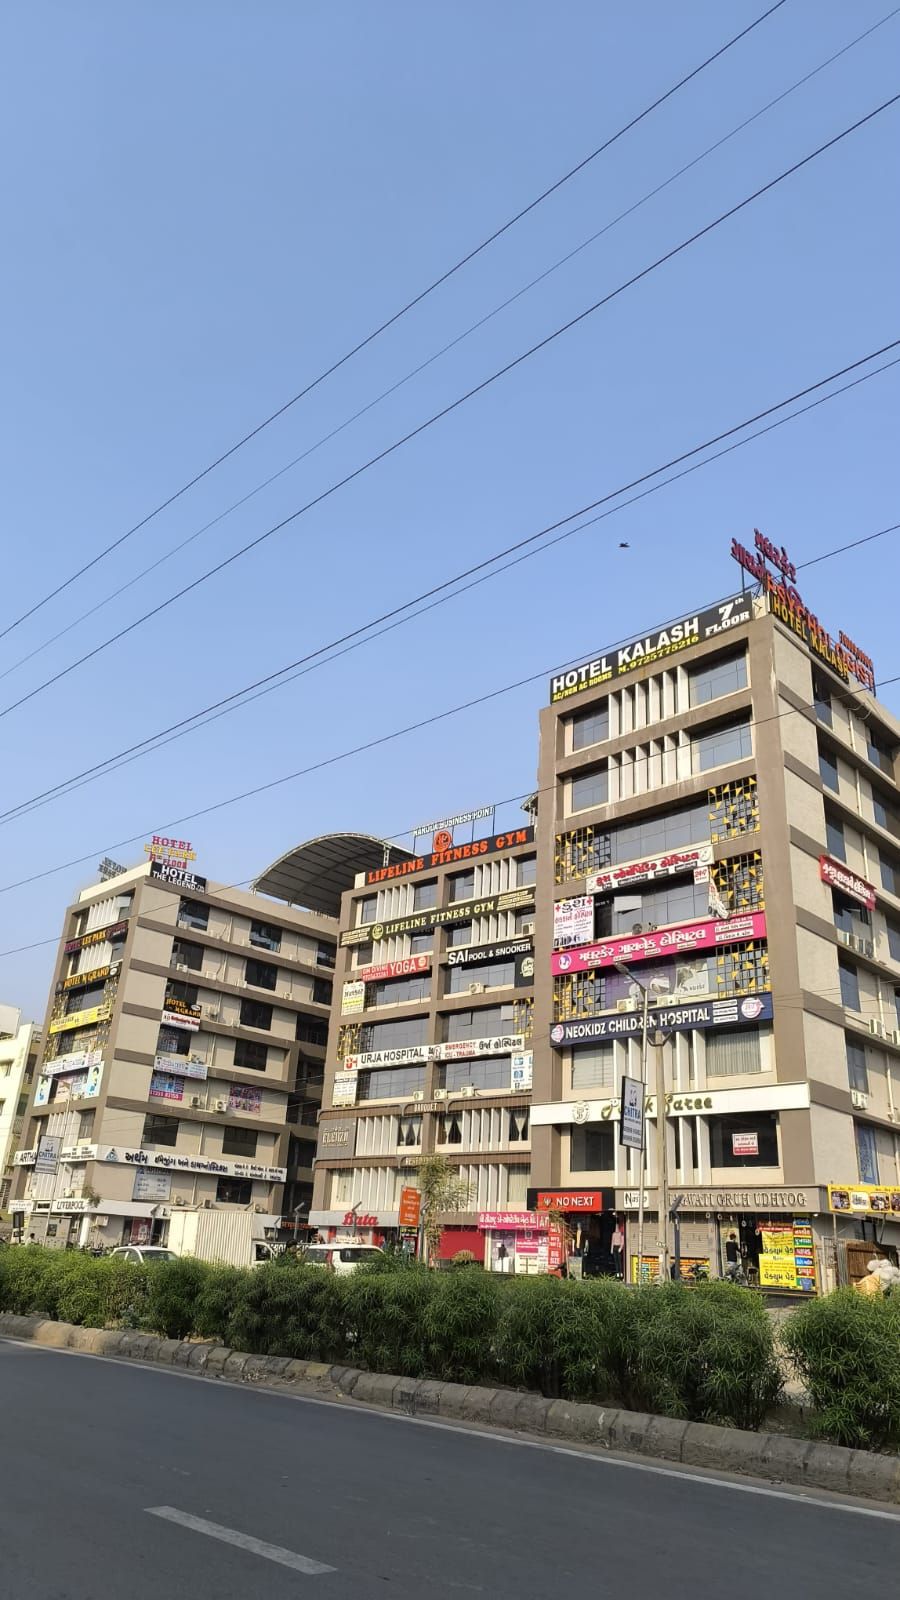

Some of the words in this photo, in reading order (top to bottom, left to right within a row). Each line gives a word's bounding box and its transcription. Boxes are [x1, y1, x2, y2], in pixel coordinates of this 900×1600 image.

[719, 598, 744, 622] 7th
[705, 611, 750, 637] FLOOR
[774, 596, 807, 641] HOTEL
[811, 632, 850, 678] KALASH
[552, 656, 612, 693] HOTEL
[617, 617, 700, 667] KALASH
[589, 671, 612, 688] ROOMS
[472, 805, 495, 820] POINT
[152, 836, 193, 851] HOTEL
[368, 857, 424, 883] LIFELINE
[431, 840, 488, 866] FITNESS
[495, 830, 528, 849] GYM
[152, 870, 167, 881] THE
[168, 876, 196, 891] LEGEND
[161, 865, 197, 885] HOTEL
[386, 917, 427, 934] LIFELINE
[430, 908, 471, 924] FITNESS
[473, 901, 494, 914] GYM
[448, 949, 469, 966] SAI
[469, 950, 487, 961] POOL
[488, 949, 494, 957] &
[495, 943, 531, 956] SNOOKER
[390, 959, 416, 975] YOGA
[64, 976, 81, 990] HOTEL
[166, 998, 187, 1008] HOTEL
[566, 1023, 606, 1039] NEOKIDZ
[660, 1008, 710, 1026] HOSPITAL
[361, 1053, 382, 1064] URJA
[384, 1048, 424, 1062] HOSPITAL
[414, 1103, 438, 1113] BANQUET
[556, 1197, 569, 1207] NO
[571, 1196, 594, 1206] NEXT
[716, 1193, 750, 1208] GRUH
[753, 1192, 807, 1208] UDHYOG
